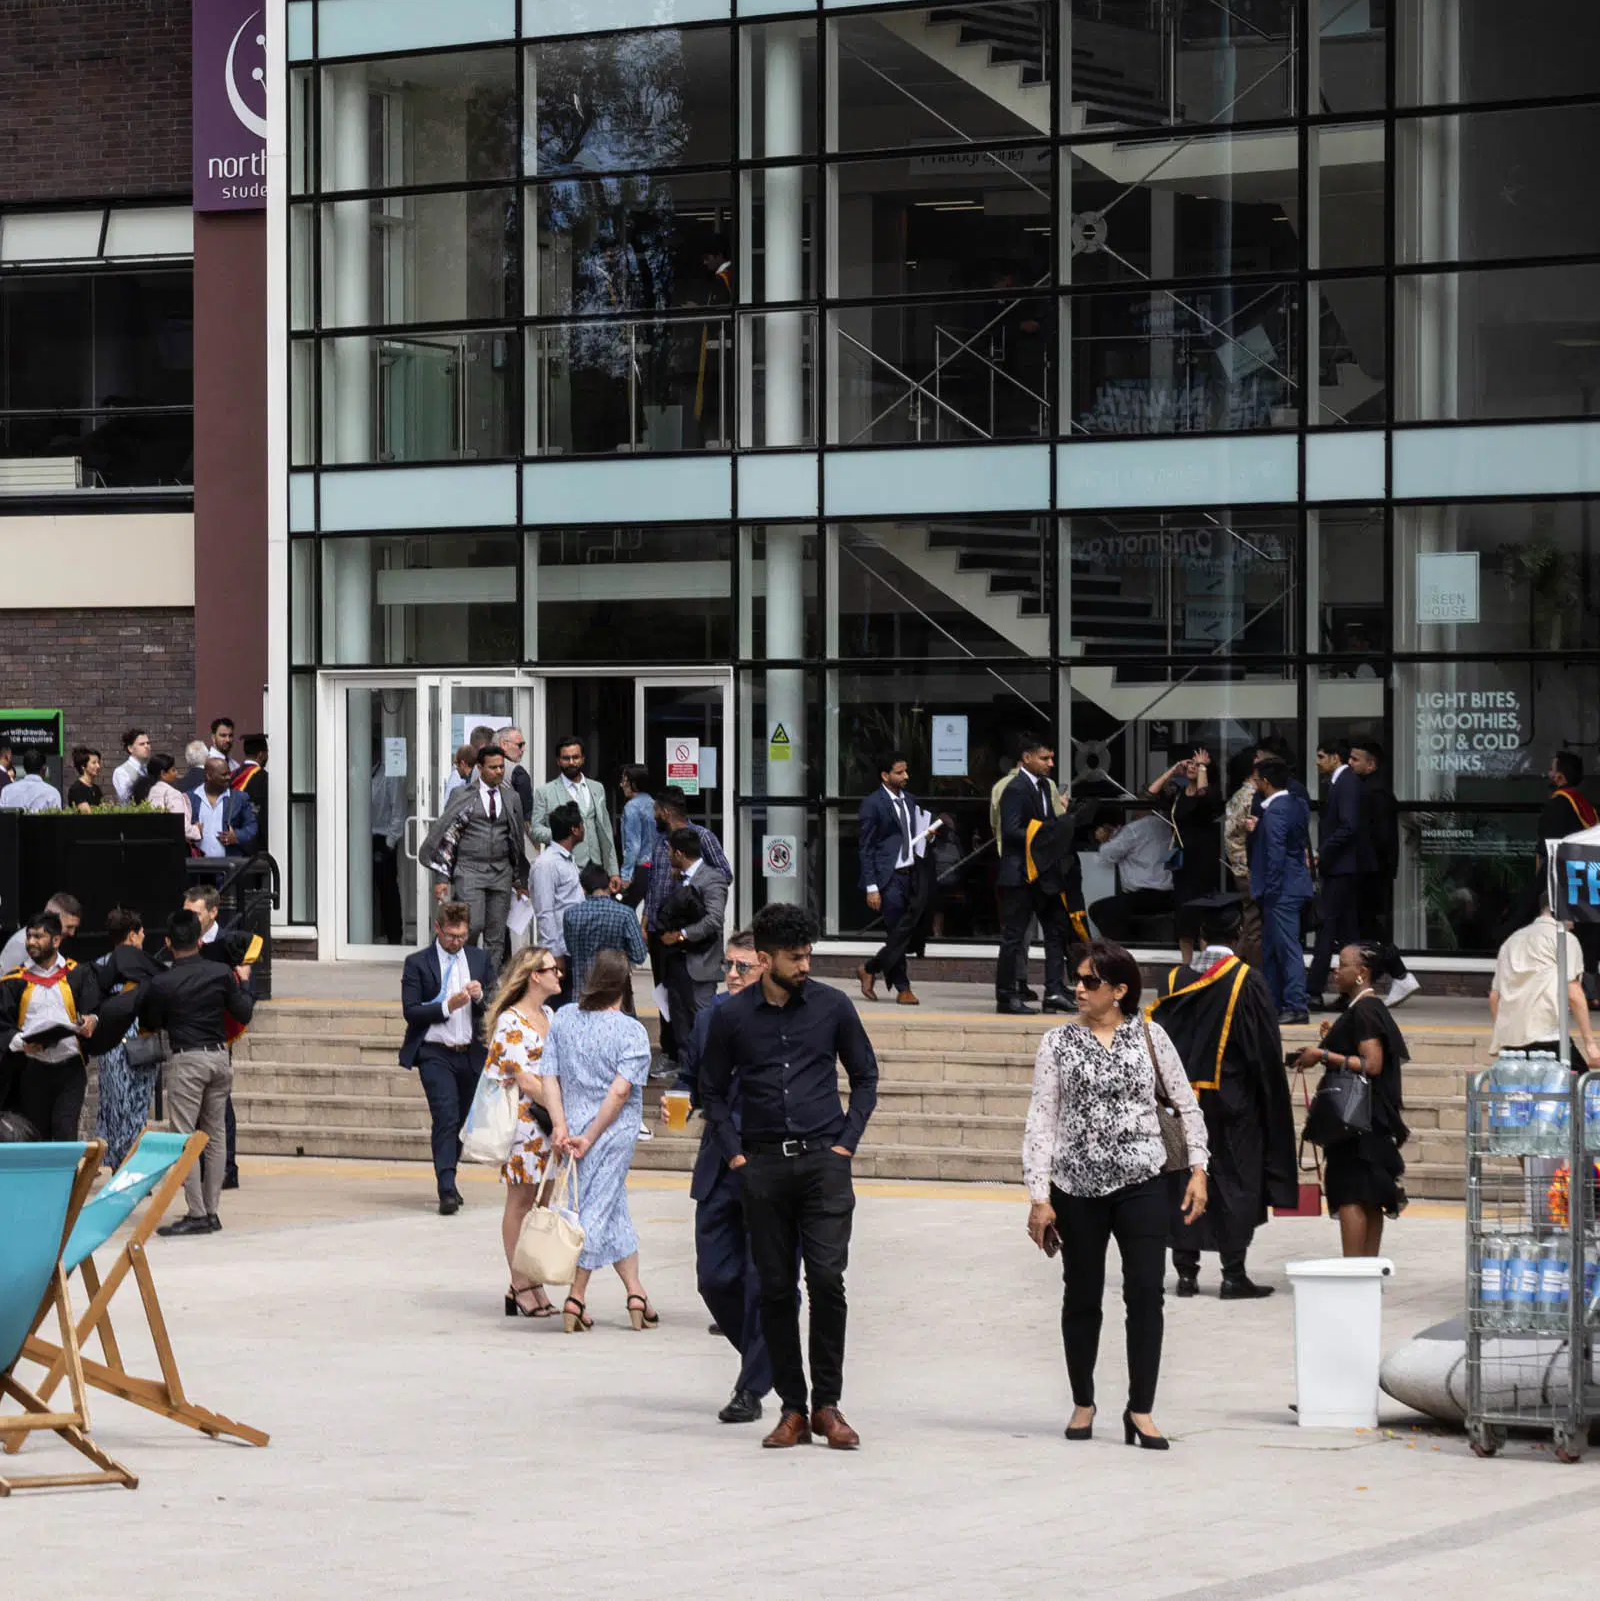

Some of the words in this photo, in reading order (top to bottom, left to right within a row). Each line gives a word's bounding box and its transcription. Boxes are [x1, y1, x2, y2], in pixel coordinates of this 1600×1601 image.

[1417, 692, 1467, 708] LIGHT
[1471, 691, 1520, 710] BITES,
[1417, 712, 1522, 730] SMOOTHIES,
[1417, 734, 1452, 750] HOT
[1456, 733, 1469, 750] &
[1473, 733, 1520, 750] COLD
[1417, 754, 1486, 771] DRINKS.
[1421, 829, 1474, 838] INGREDIENTS
